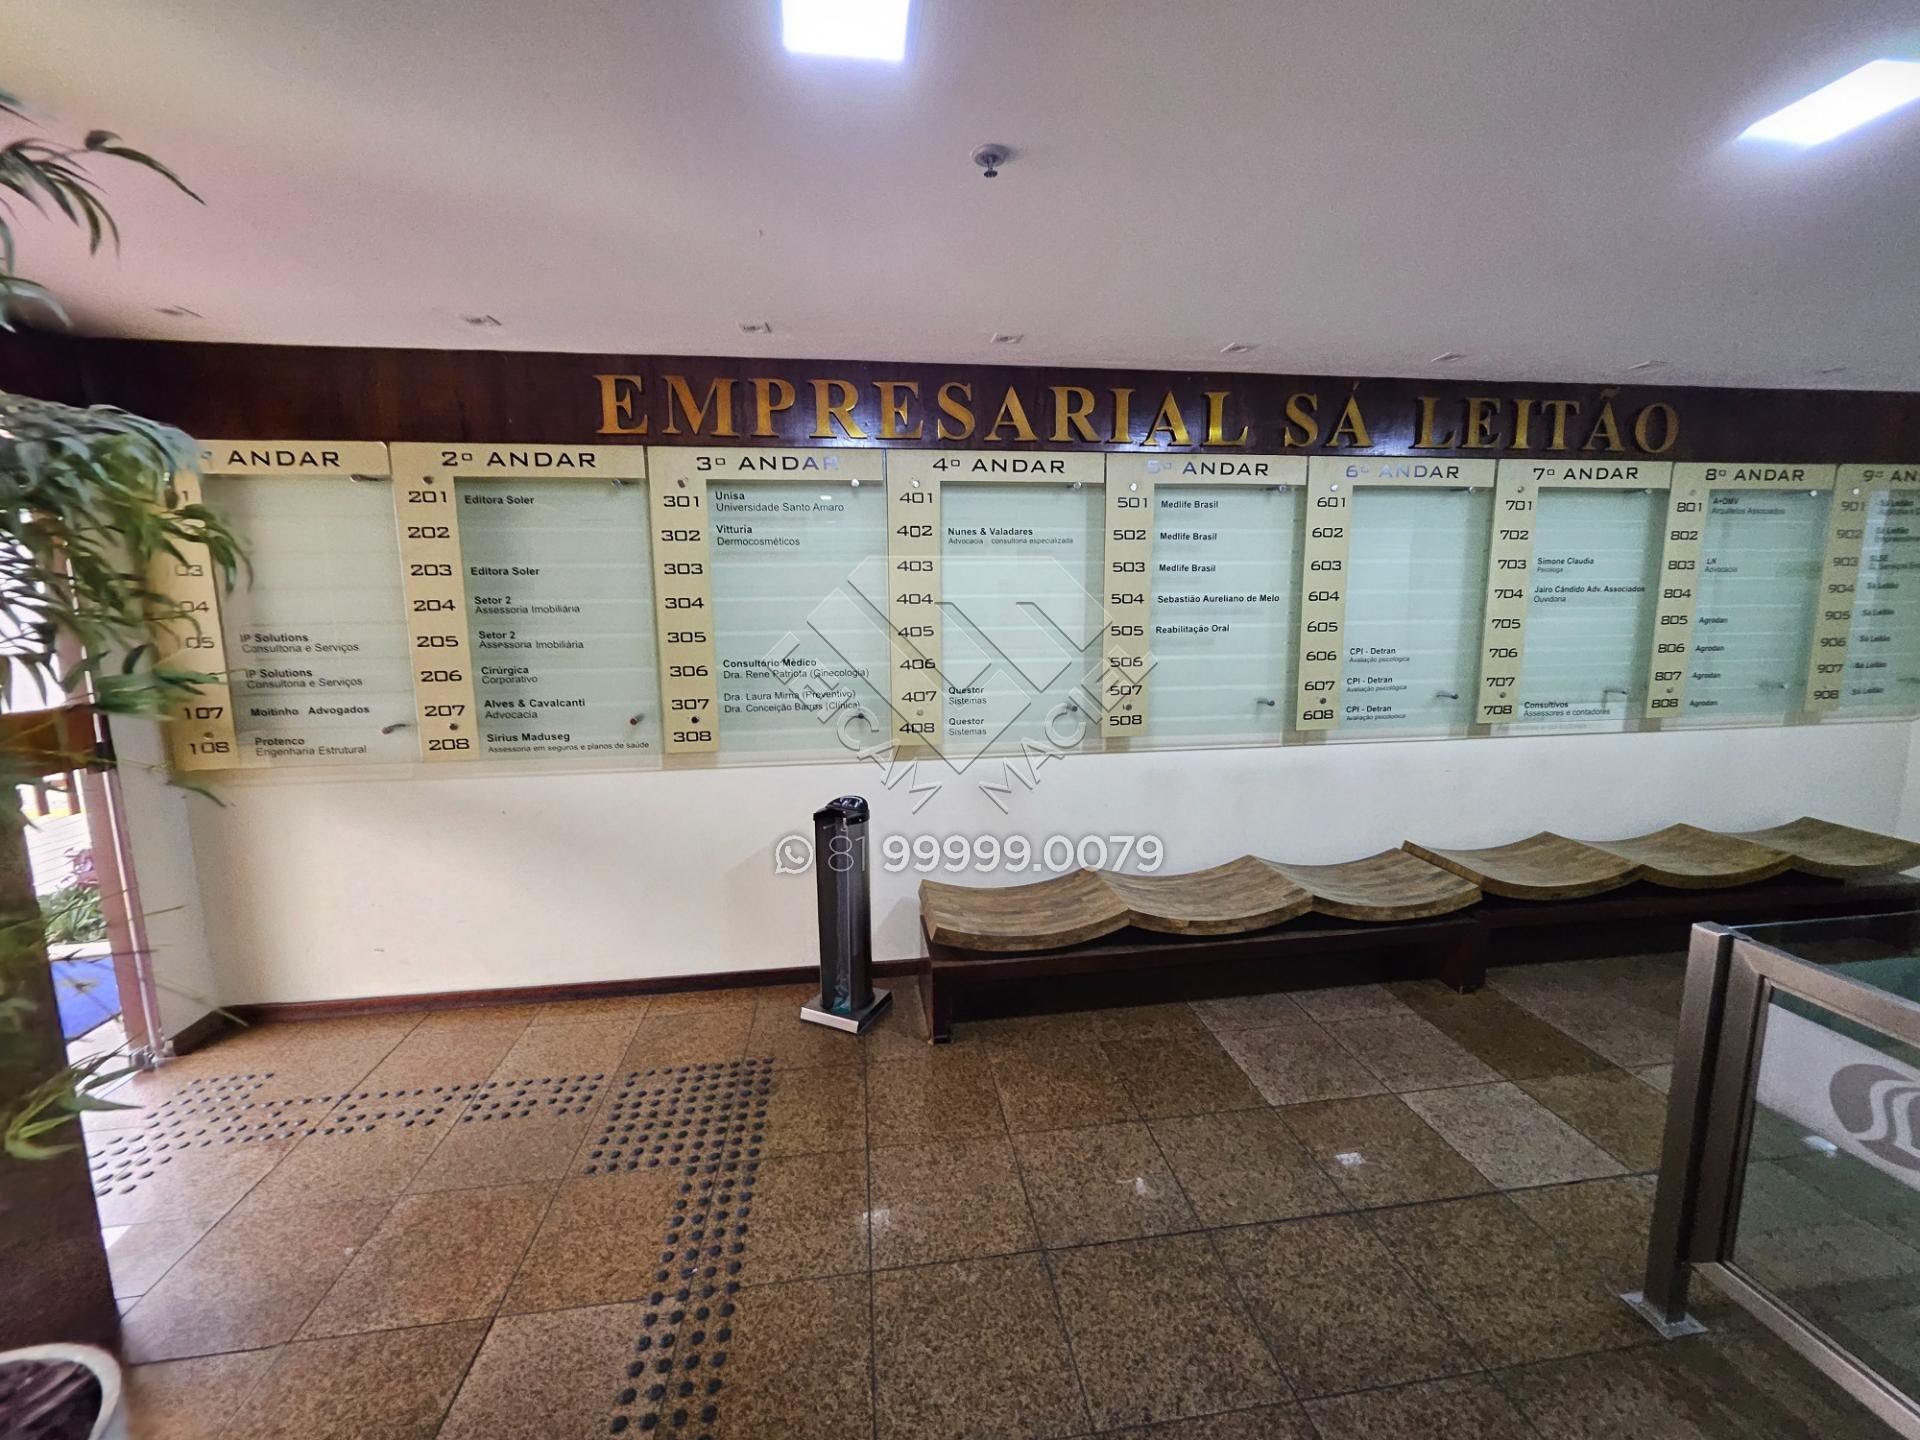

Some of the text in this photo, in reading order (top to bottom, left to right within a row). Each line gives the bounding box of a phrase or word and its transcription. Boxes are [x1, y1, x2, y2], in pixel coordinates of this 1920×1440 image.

[596, 373, 1679, 456] EMPRESARIAL SÁ LEITÃO
[228, 451, 341, 467] ANDAR
[487, 452, 597, 467] ANDAR
[739, 456, 839, 471] ANDAR
[972, 459, 1065, 473] ANDAR
[1182, 461, 1269, 476] ANDAR
[1378, 464, 1460, 478] ANDAR
[1563, 467, 1638, 480] ANDAR
[1735, 469, 1804, 481] ANDAR
[408, 491, 447, 503] 201
[464, 496, 535, 505] Editora Soler
[715, 491, 745, 501] Unisa
[899, 493, 933, 503] 401
[663, 496, 700, 507] 301
[1117, 497, 1147, 508] 501
[1161, 500, 1219, 508] Medlife Brasil
[1317, 497, 1346, 508] 601
[1506, 500, 1532, 511] 701
[716, 502, 844, 512] Universidade Santo Amaro
[1677, 503, 1702, 512] 801
[408, 527, 450, 539] 202
[716, 524, 753, 534] Vitturia
[897, 526, 933, 537] 402
[948, 527, 1033, 536] Nunes & Valadares
[1312, 527, 1343, 538] 602
[662, 530, 700, 541] 302
[1113, 530, 1146, 541] 502
[1160, 532, 1217, 540] Medlife Brasil
[1500, 530, 1528, 540] 702
[1671, 531, 1698, 540] 802
[717, 536, 800, 546] Dermocosméticos
[1311, 560, 1342, 571] 603
[1498, 559, 1526, 569] 703
[1537, 557, 1594, 565] Simone Claudia
[1668, 560, 1695, 570] 803
[410, 565, 452, 576] 203
[471, 567, 540, 576] Editora Soler
[664, 563, 703, 574] 303
[897, 561, 933, 572] 403
[1113, 561, 1145, 573] 503
[1159, 564, 1216, 572] Medlife Brasil
[1495, 589, 1523, 599] 704
[1534, 585, 1645, 593] Jairo Cândido Adv. Associados
[1664, 589, 1691, 598] 804
[474, 596, 512, 605] Setor 2
[897, 594, 933, 604] 404
[1111, 593, 1144, 604] 504
[1157, 594, 1280, 603] Sebastião Aureliano de Melo
[1308, 591, 1339, 601] 604
[413, 600, 456, 612] 204
[665, 598, 704, 609] 304
[475, 605, 528, 614] Assessoria
[1661, 616, 1688, 625] 805
[1825, 611, 1851, 620] 905
[1156, 624, 1229, 634] Reabilitação Oral
[1307, 622, 1338, 632] 605
[1492, 619, 1521, 629] 705
[479, 631, 516, 639] Setor 2
[898, 626, 934, 637] 405
[1111, 625, 1144, 636] 505
[417, 636, 459, 648] 205
[667, 632, 706, 642] 305
[1821, 637, 1846, 647] 906
[479, 640, 532, 649] Assessoria
[1658, 644, 1685, 653] 806
[1306, 651, 1337, 661] 606
[1489, 648, 1517, 658] 706
[900, 658, 936, 670] 406
[1110, 656, 1143, 667] 506
[481, 666, 529, 676] Cirúrgica
[670, 666, 708, 677] 306
[723, 670, 742, 678] Dra.
[746, 670, 770, 678] Rene
[810, 668, 869, 679] (Ginecologia)
[1818, 664, 1843, 673] 907
[420, 671, 462, 682] 206
[482, 675, 538, 685] Corporativo
[1655, 672, 1681, 681] 807
[1304, 680, 1335, 691] 607
[1486, 677, 1515, 687] 707
[724, 693, 743, 701] Dra.
[746, 691, 772, 701] Laura
[802, 689, 856, 700] (Preventivo)
[948, 686, 984, 696] Questor
[1110, 685, 1143, 696] 507
[1814, 690, 1839, 700] 908
[902, 691, 937, 702] 407
[948, 696, 987, 705] Sistemas
[485, 698, 585, 708] Alves & Cavalcanti
[671, 699, 709, 710] 307
[1652, 699, 1678, 708] 808
[184, 707, 223, 719] 107
[250, 706, 370, 716] Moitinho Advogados
[424, 705, 465, 717] 207
[485, 710, 538, 719] Advocacia
[1303, 710, 1334, 720] 608
[1484, 705, 1512, 715] 708
[948, 717, 984, 727] Questor
[1110, 715, 1142, 726] 508
[899, 723, 935, 733] 408
[948, 727, 987, 736] Sistemas
[487, 732, 570, 742] Sirius Maduseg
[673, 731, 711, 742] 308
[190, 742, 230, 754] 108
[429, 738, 470, 750] 208
[255, 745, 367, 758] Engenharia Estrutural
